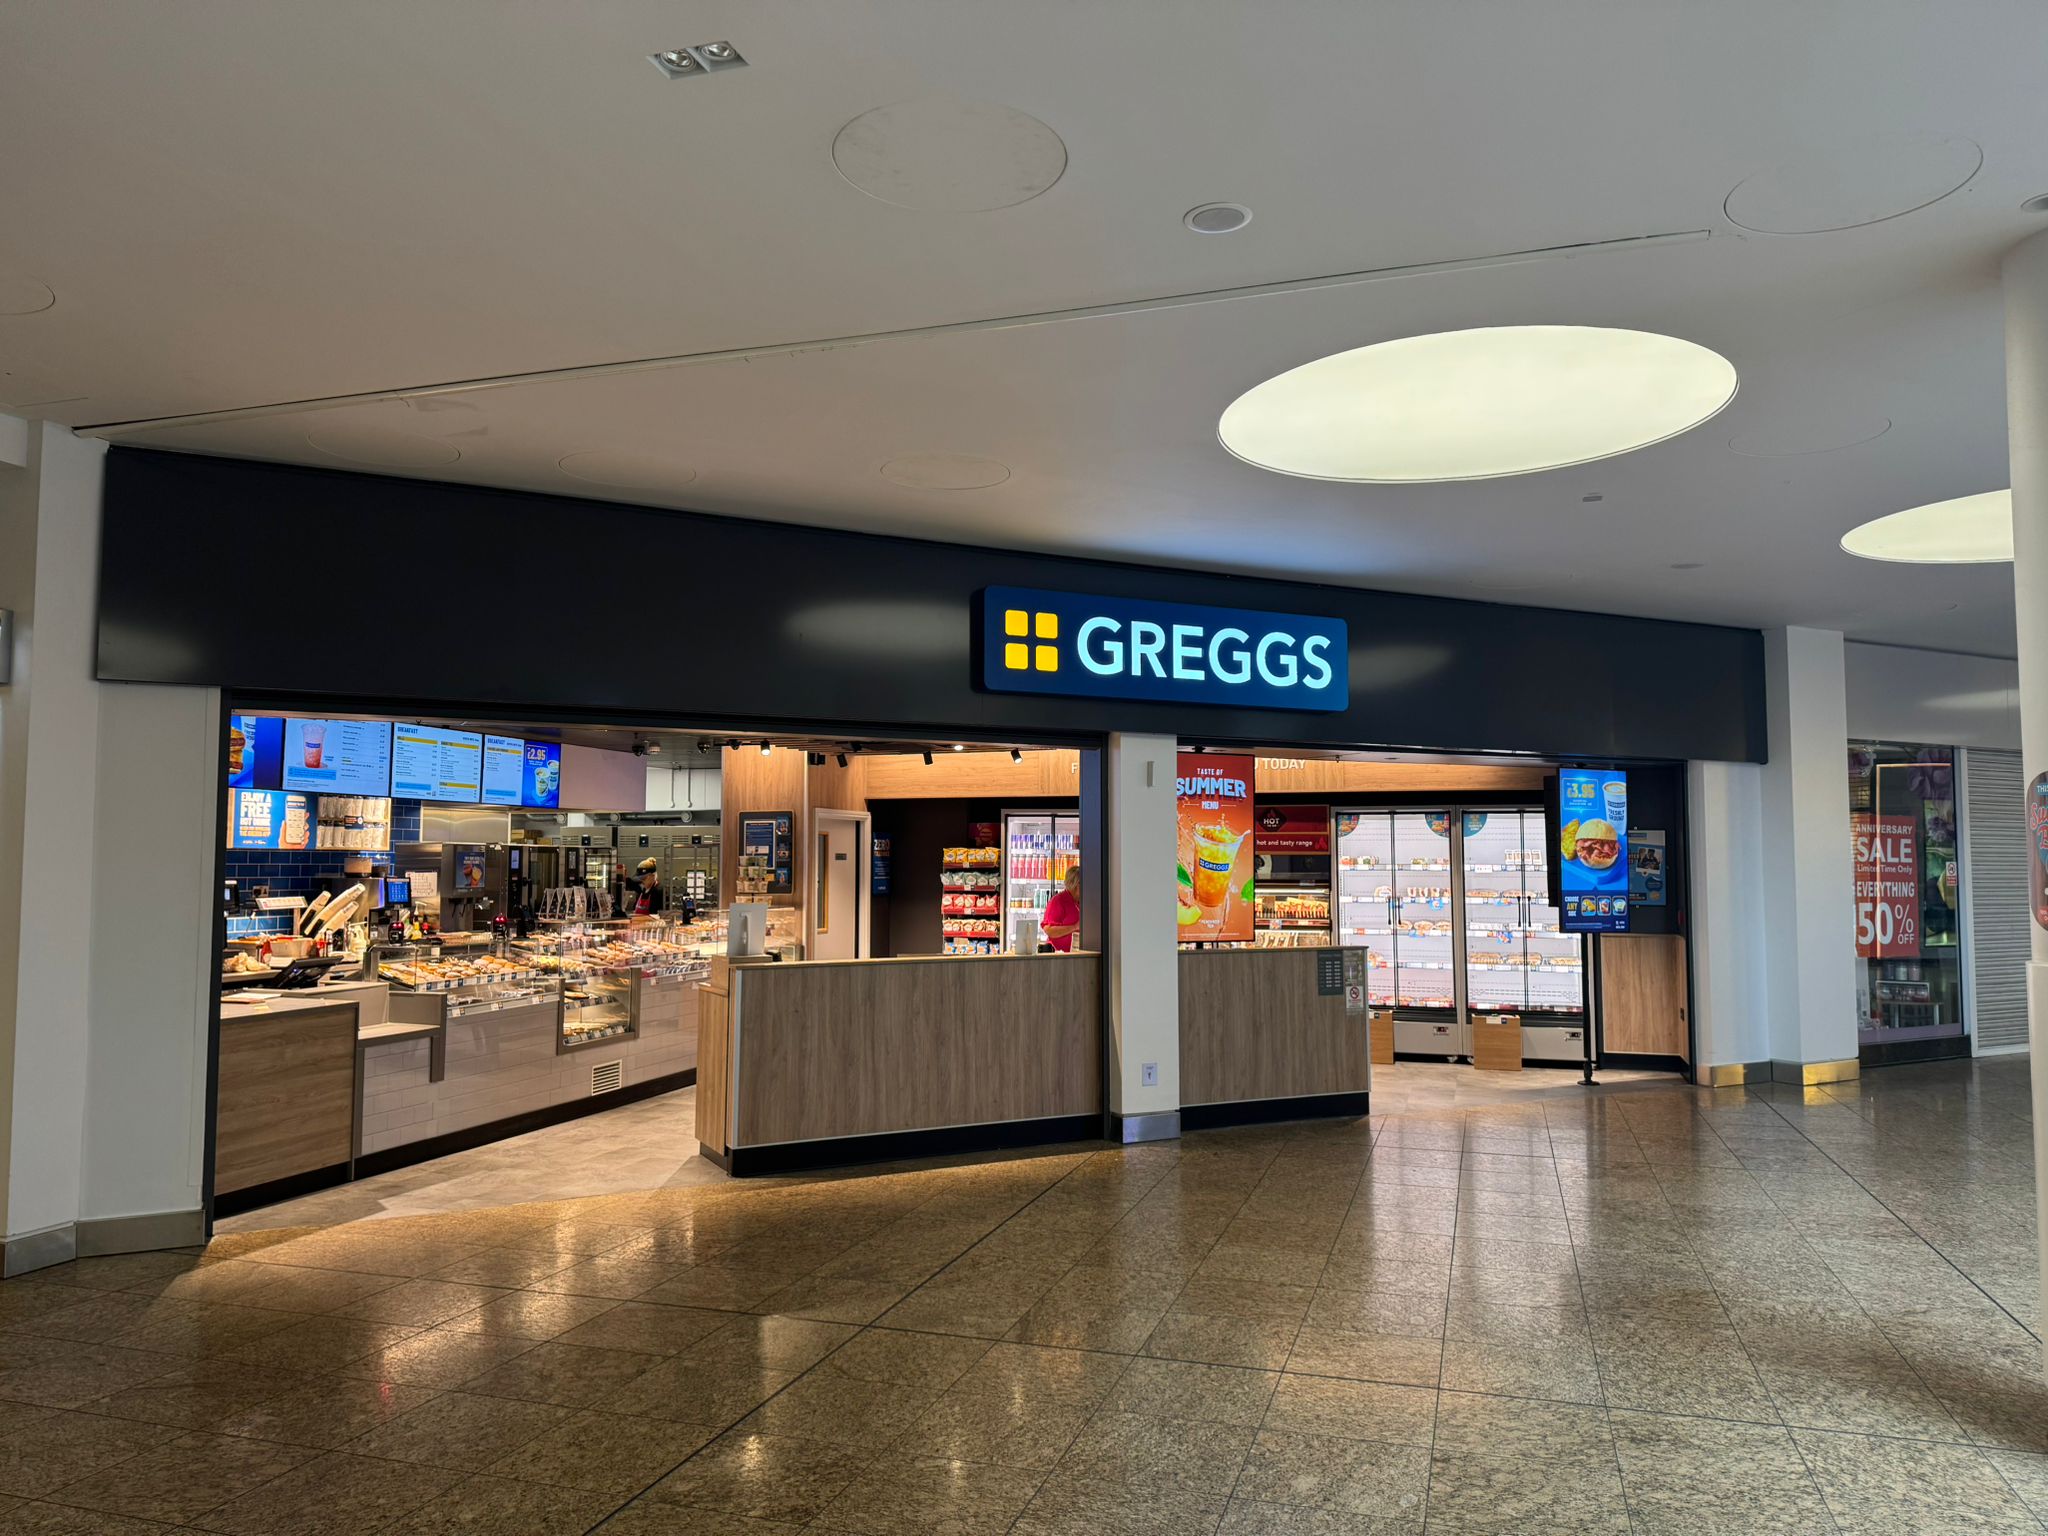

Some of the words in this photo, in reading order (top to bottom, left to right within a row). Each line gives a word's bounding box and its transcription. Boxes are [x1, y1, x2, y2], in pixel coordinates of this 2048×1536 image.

[1077, 616, 1332, 689] GREGGS
[1263, 758, 1307, 770] TODAY
[1176, 777, 1247, 798] SUMMER
[241, 801, 271, 818] FREE
[1202, 801, 1219, 809] MENU
[1856, 824, 1913, 834] ANNIVERSARY
[1280, 839, 1294, 847] tasty
[1857, 836, 1913, 863] SALE
[1880, 865, 1897, 873] Time
[1897, 864, 1913, 875] Only
[1857, 881, 1915, 897] EVERYTHING
[1858, 902, 1914, 945] 50%
[1897, 934, 1915, 945] OFF
